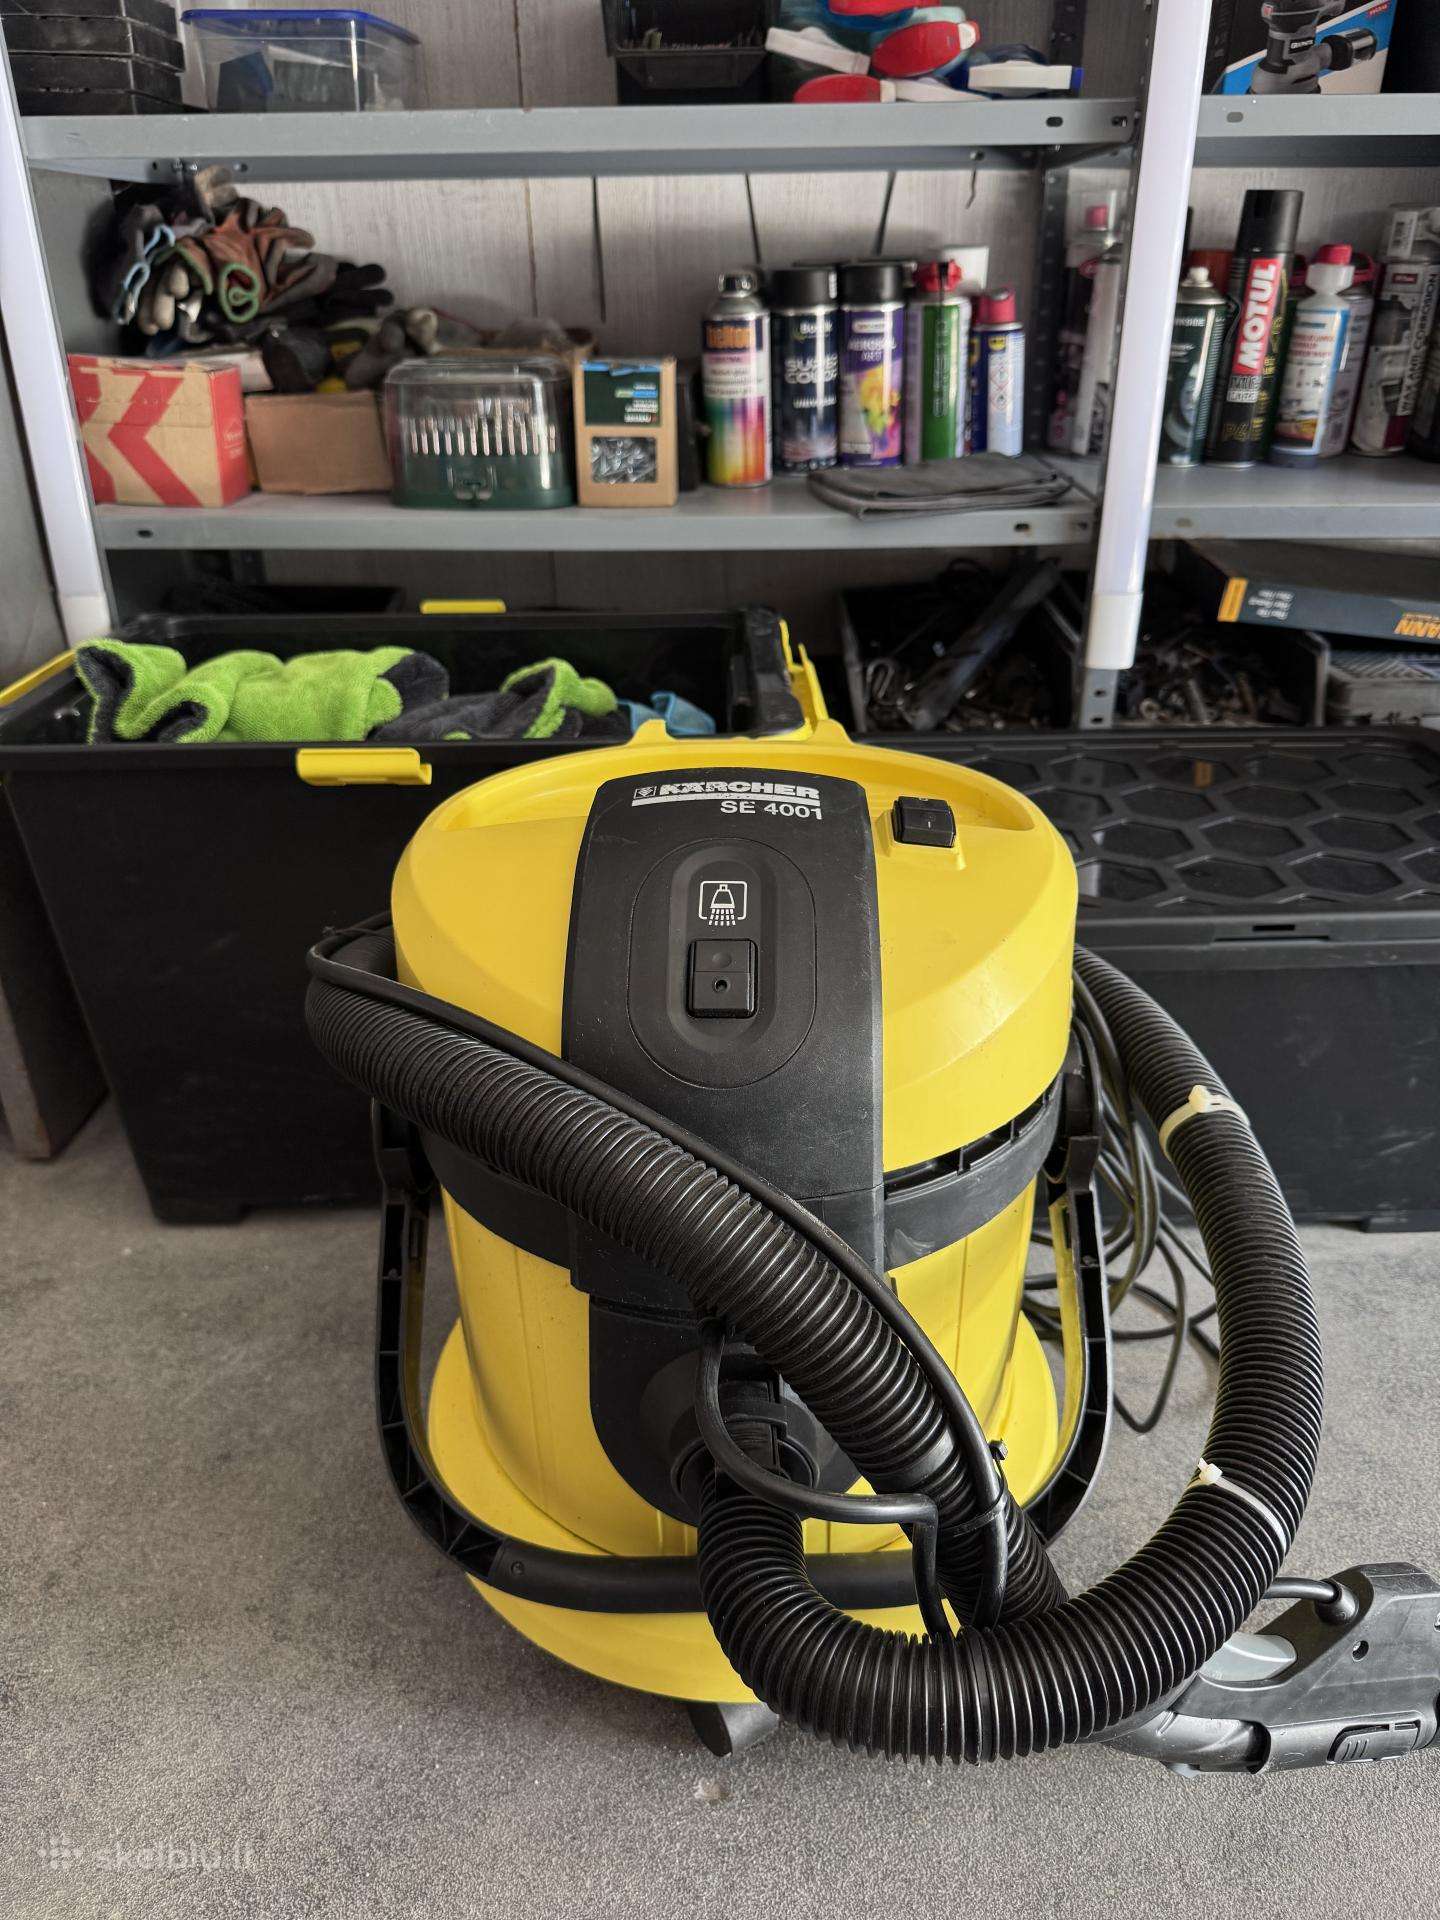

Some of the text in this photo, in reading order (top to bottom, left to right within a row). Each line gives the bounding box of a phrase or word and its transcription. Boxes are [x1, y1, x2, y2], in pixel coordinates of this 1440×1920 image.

[1237, 263, 1276, 369] MOTUL
[720, 800, 823, 820] SE 4001
